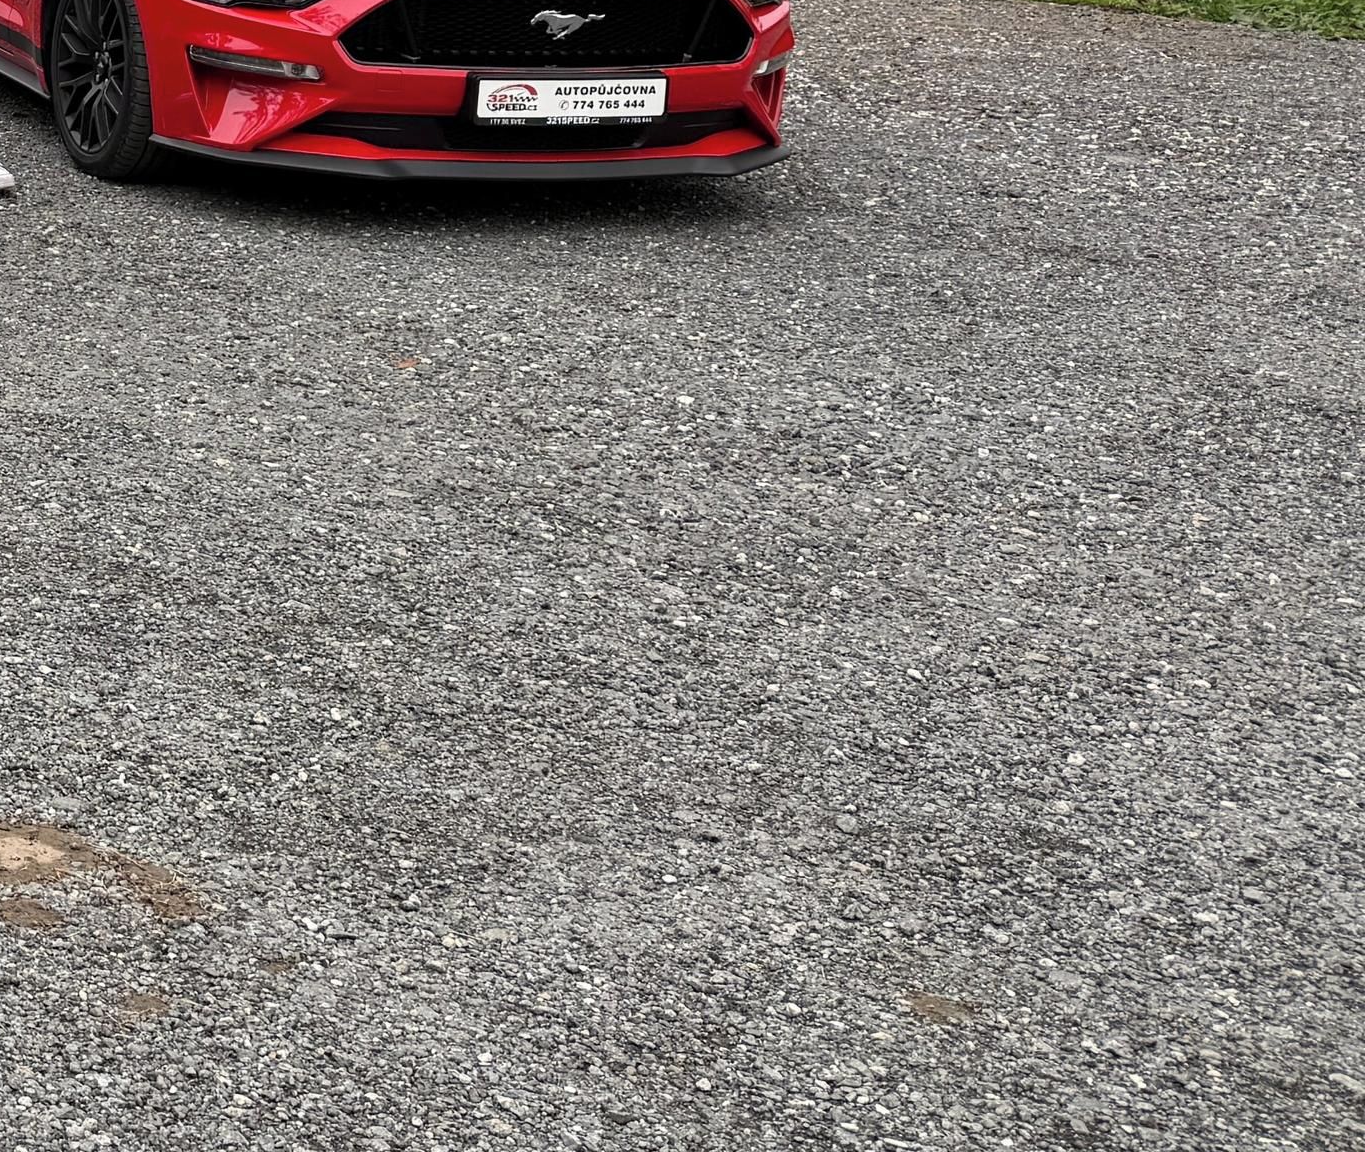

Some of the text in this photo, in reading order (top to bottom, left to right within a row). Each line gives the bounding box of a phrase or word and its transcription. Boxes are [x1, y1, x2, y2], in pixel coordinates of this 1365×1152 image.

[555, 83, 657, 96] AUTOPŮJČOVNA
[572, 99, 645, 110] 774 765 444
